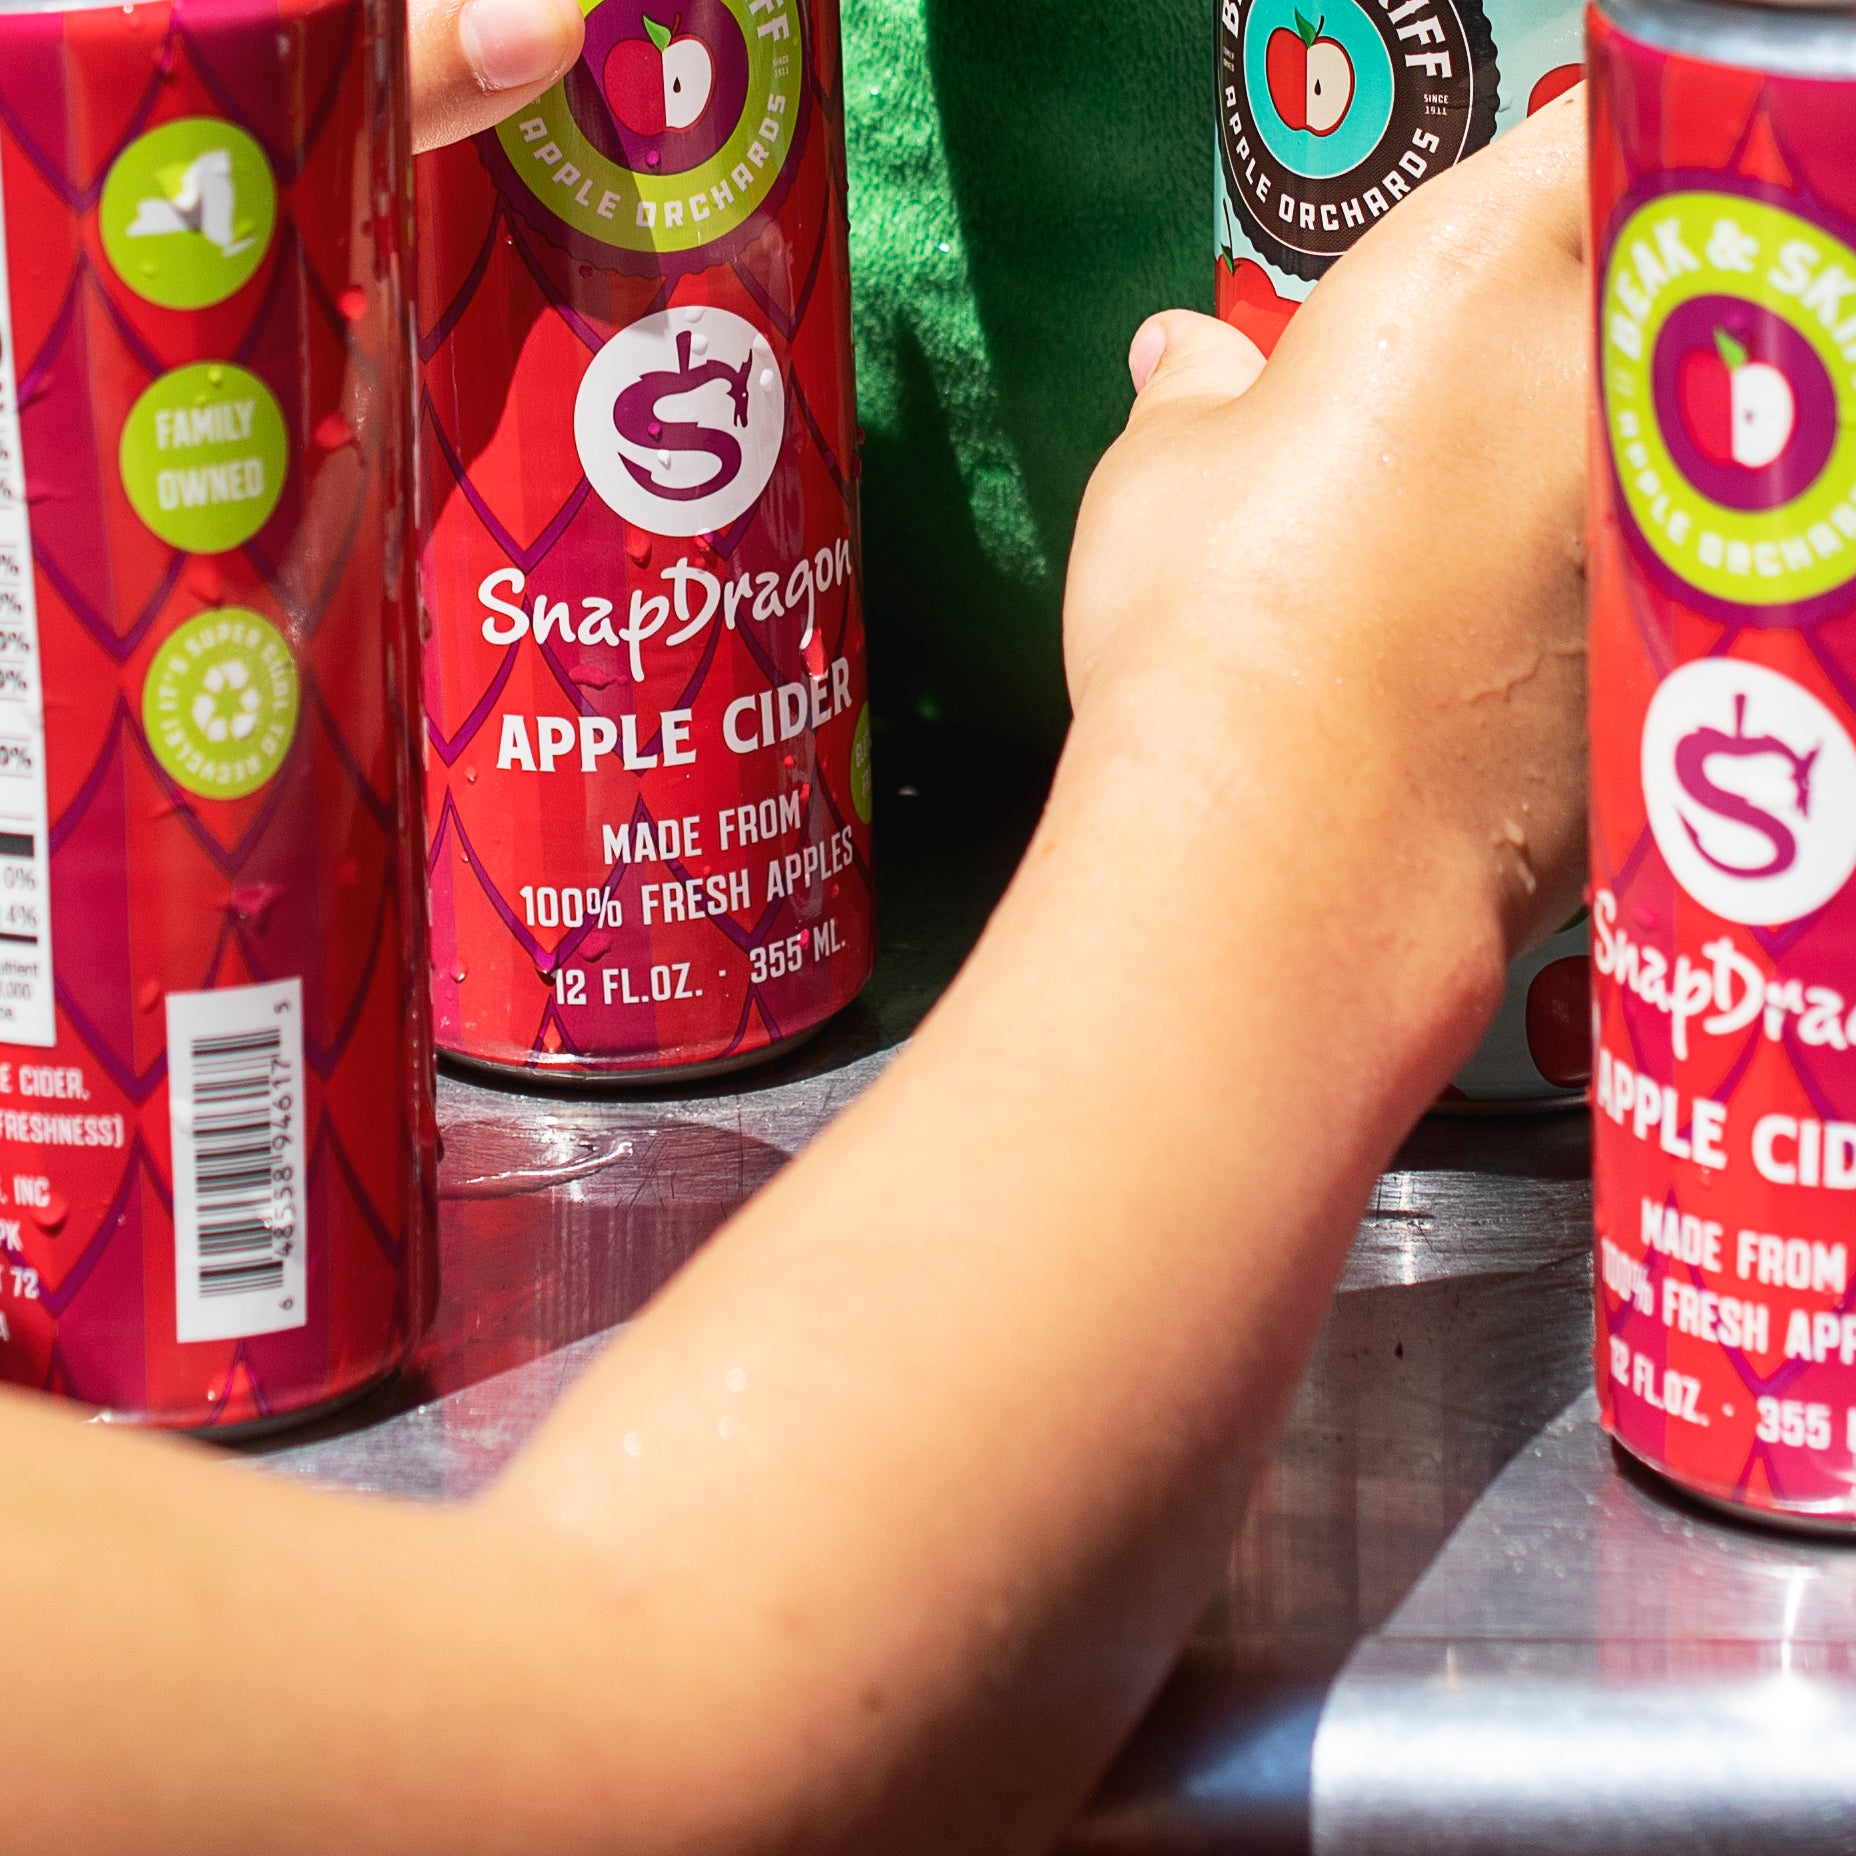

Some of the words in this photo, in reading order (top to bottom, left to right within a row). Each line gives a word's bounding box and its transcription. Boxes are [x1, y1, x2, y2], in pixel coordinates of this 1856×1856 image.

[1423, 94, 1449, 104] SINCE
[1425, 105, 1447, 116] 1911
[518, 117, 623, 221] APPLE
[635, 93, 786, 228] ORCHARDS
[1225, 84, 1271, 204] APPLE
[1278, 126, 1440, 233] ORCHARDS
[1611, 216, 1700, 363] BEAK
[1705, 218, 1757, 273] &
[155, 399, 255, 450] FAMILY
[156, 457, 265, 511] OWNED
[1619, 412, 1691, 546] APPLE
[477, 537, 853, 683] SnapDragon
[496, 707, 698, 773] APPLE
[722, 655, 853, 754] CIDER
[602, 815, 702, 865] MADE
[717, 789, 802, 852] FROM
[519, 884, 623, 929] 100%
[642, 868, 751, 926] FRESH
[766, 824, 854, 902] APPLES
[553, 968, 587, 1006] 12
[603, 961, 703, 1005] FL.OZ.
[749, 933, 803, 985] 355
[812, 917, 847, 963] ML.
[273, 1001, 291, 1015] 5
[271, 1057, 293, 1152] 94617
[1597, 1047, 1728, 1171] APPLE
[13, 1174, 51, 1208] INC
[273, 1165, 295, 1258] 48558
[10, 1265, 40, 1299] 72
[1641, 1198, 1724, 1273] MADE
[1735, 1230, 1848, 1294] FROM
[278, 1297, 294, 1312] 6
[1662, 1278, 1770, 1354] FRESH
[1755, 1396, 1831, 1451] 355
